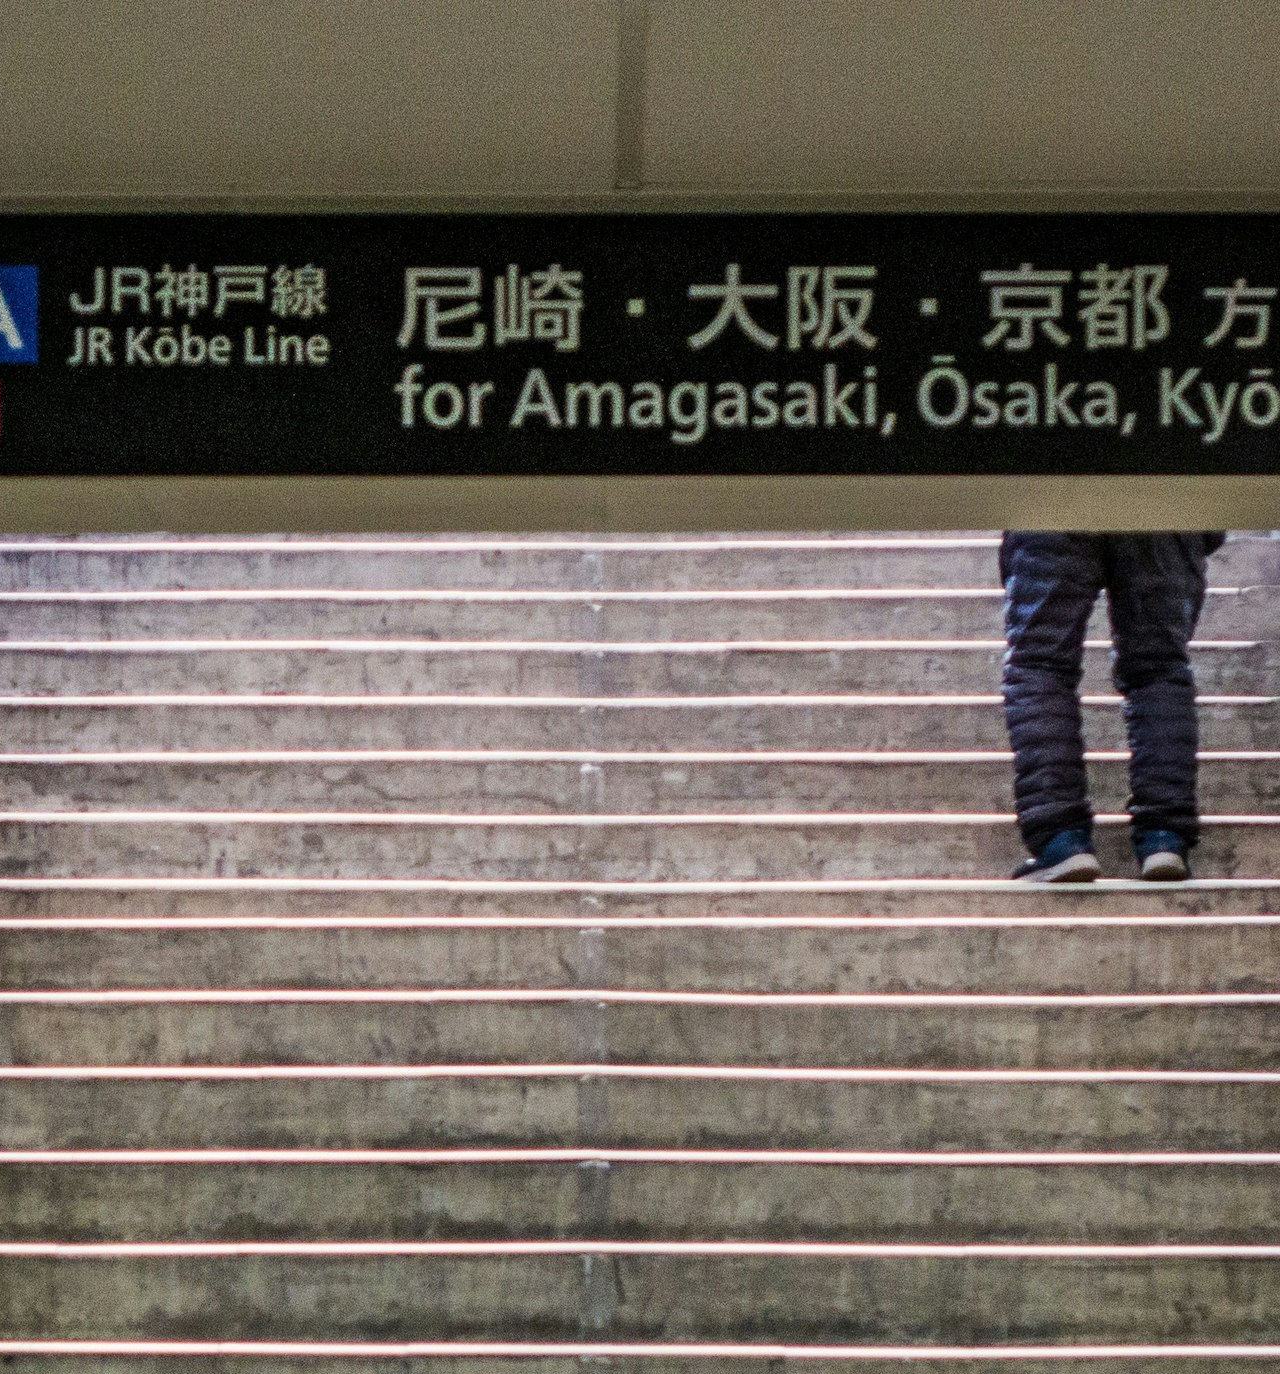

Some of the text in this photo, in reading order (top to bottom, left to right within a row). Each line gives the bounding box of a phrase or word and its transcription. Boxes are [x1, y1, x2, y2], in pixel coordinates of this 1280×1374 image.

[70, 264, 328, 318] JR神戸線
[67, 325, 331, 367] JR Kōbe Line
[394, 364, 494, 427] for
[509, 366, 896, 444] Amagasaki,
[917, 355, 1136, 437] Ōsaka,
